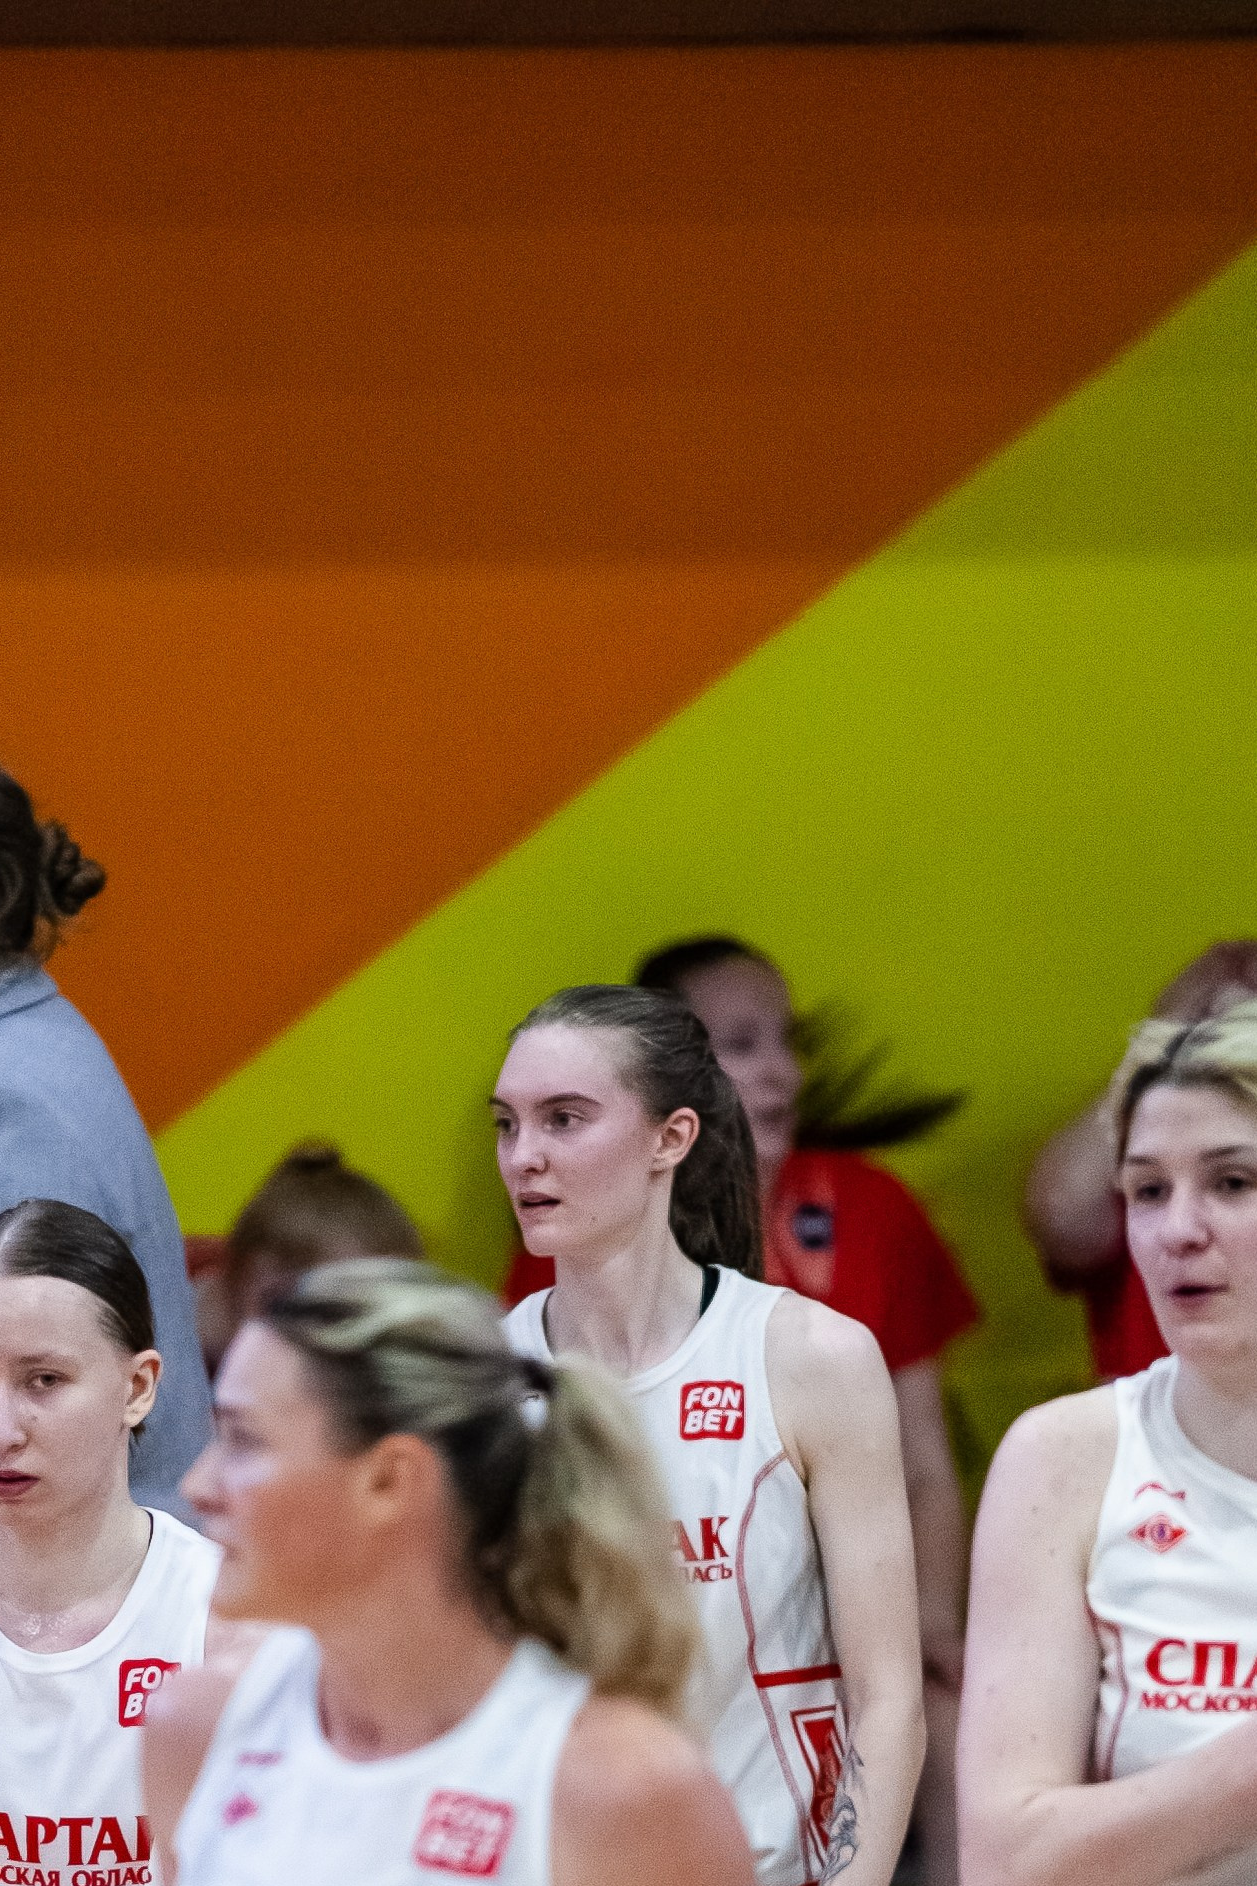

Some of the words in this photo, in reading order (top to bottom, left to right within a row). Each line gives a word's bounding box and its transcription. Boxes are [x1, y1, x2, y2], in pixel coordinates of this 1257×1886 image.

[684, 1386, 741, 1410] FON
[683, 1408, 743, 1434] BET
[124, 1665, 166, 1692] FO
